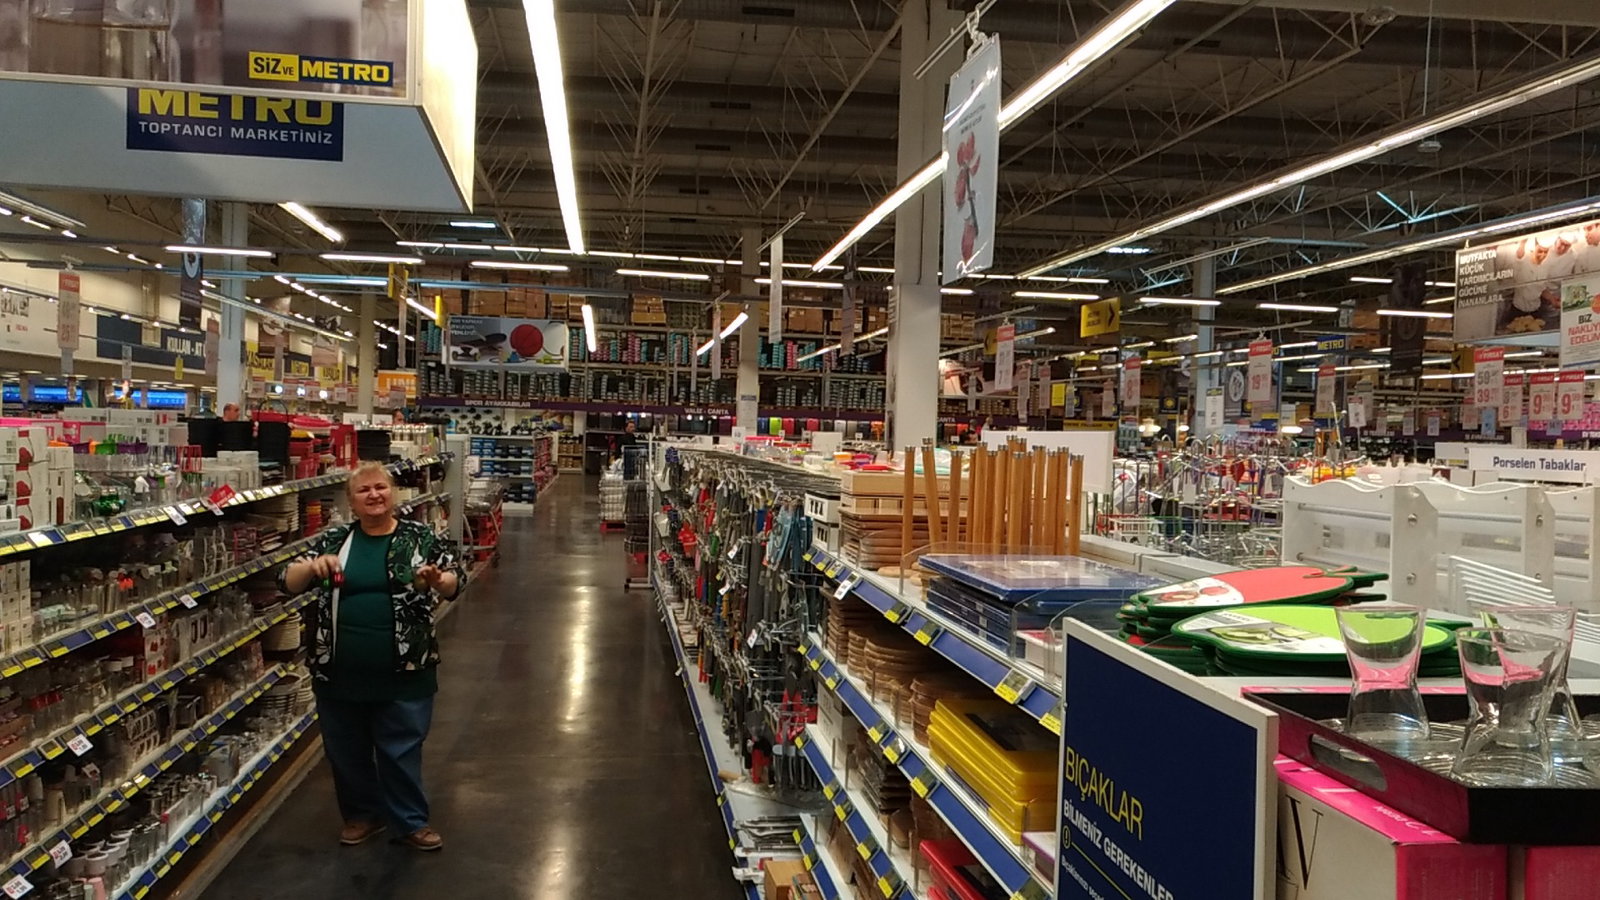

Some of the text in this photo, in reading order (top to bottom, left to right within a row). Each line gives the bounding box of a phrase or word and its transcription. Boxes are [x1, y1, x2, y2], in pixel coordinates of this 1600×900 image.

[283, 66, 294, 76] VE
[302, 60, 389, 83] METRO
[138, 88, 334, 125] METRO
[138, 121, 222, 138] TOPTANCI
[1317, 339, 1345, 350] METRO
[1493, 456, 1587, 472] Porselen Tabaklar
[1065, 746, 1143, 841] BIÇAKLAR
